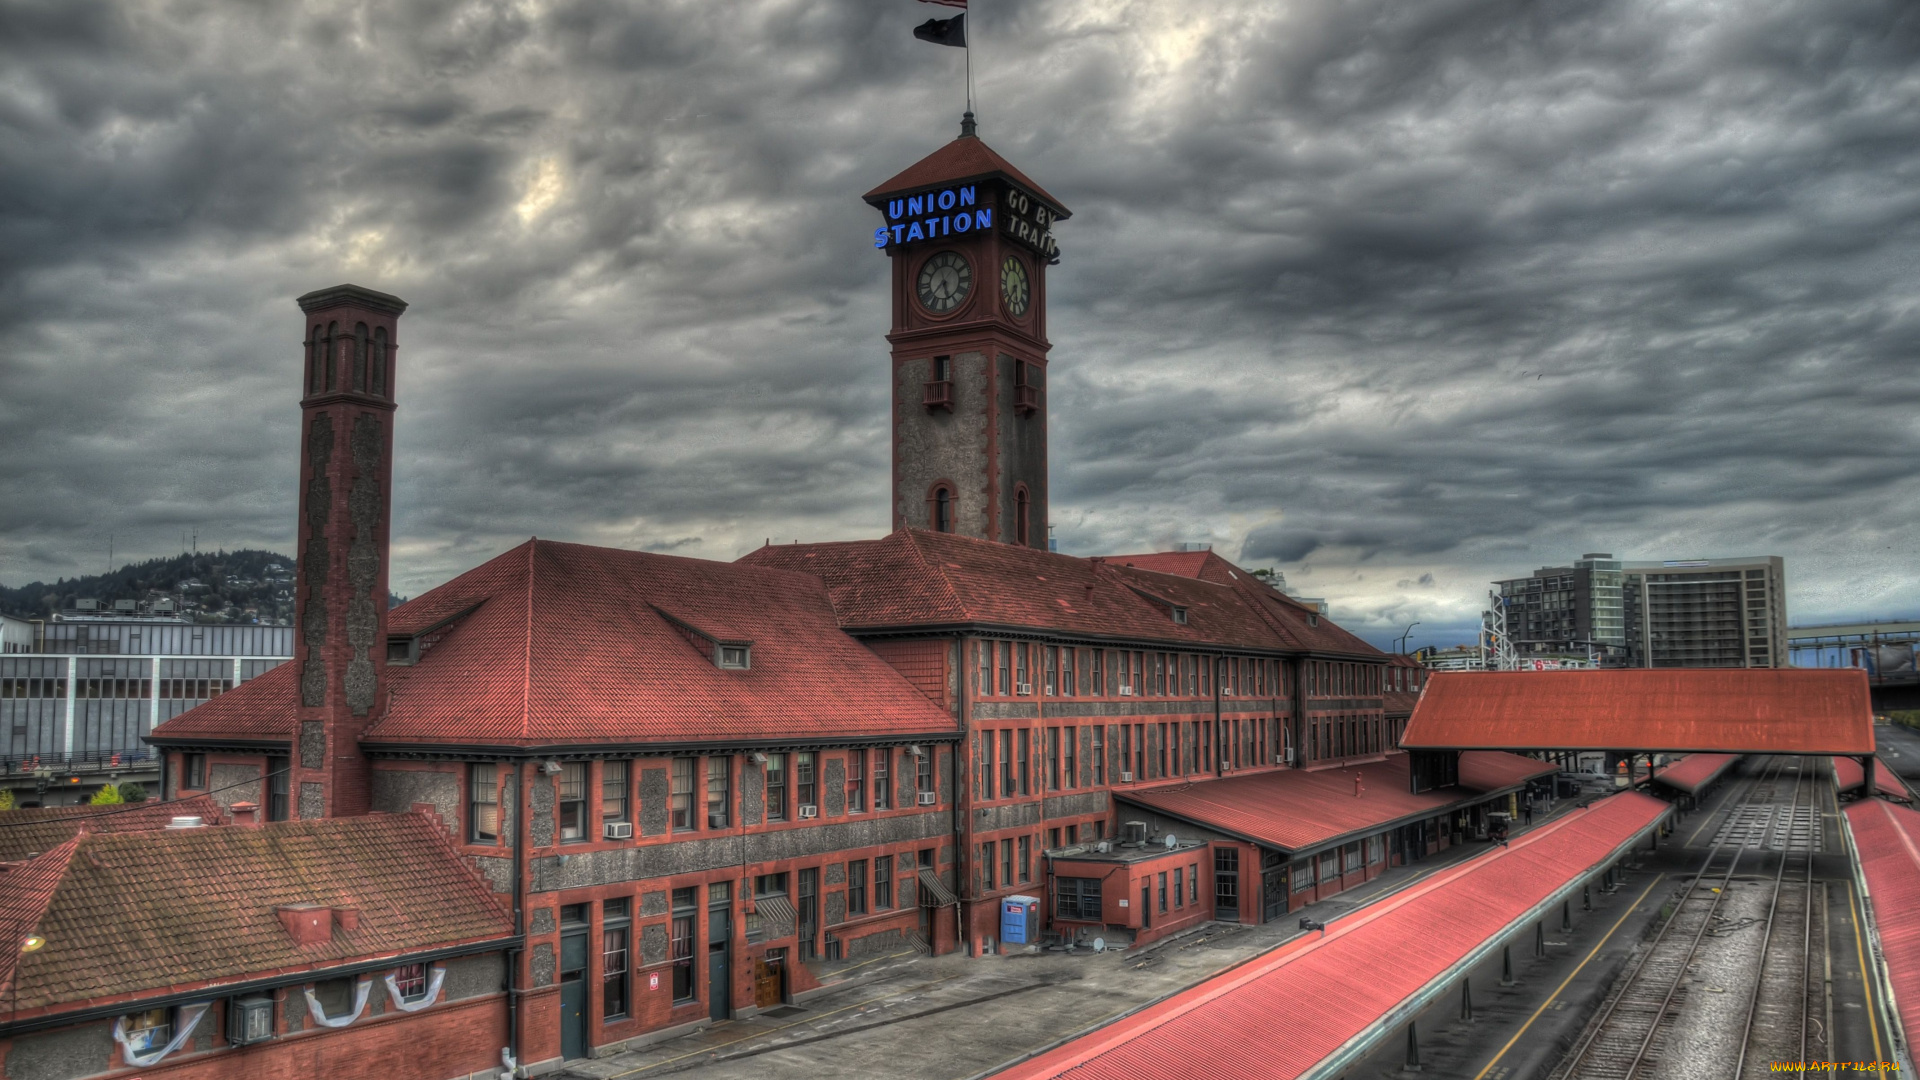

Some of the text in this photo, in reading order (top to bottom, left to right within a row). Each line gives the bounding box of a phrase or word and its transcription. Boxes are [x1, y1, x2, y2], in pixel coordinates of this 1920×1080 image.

[889, 186, 976, 220] UNION
[1009, 189, 1057, 230] GO BY
[874, 208, 992, 249] STATION
[1010, 214, 1056, 255] TRAIN
